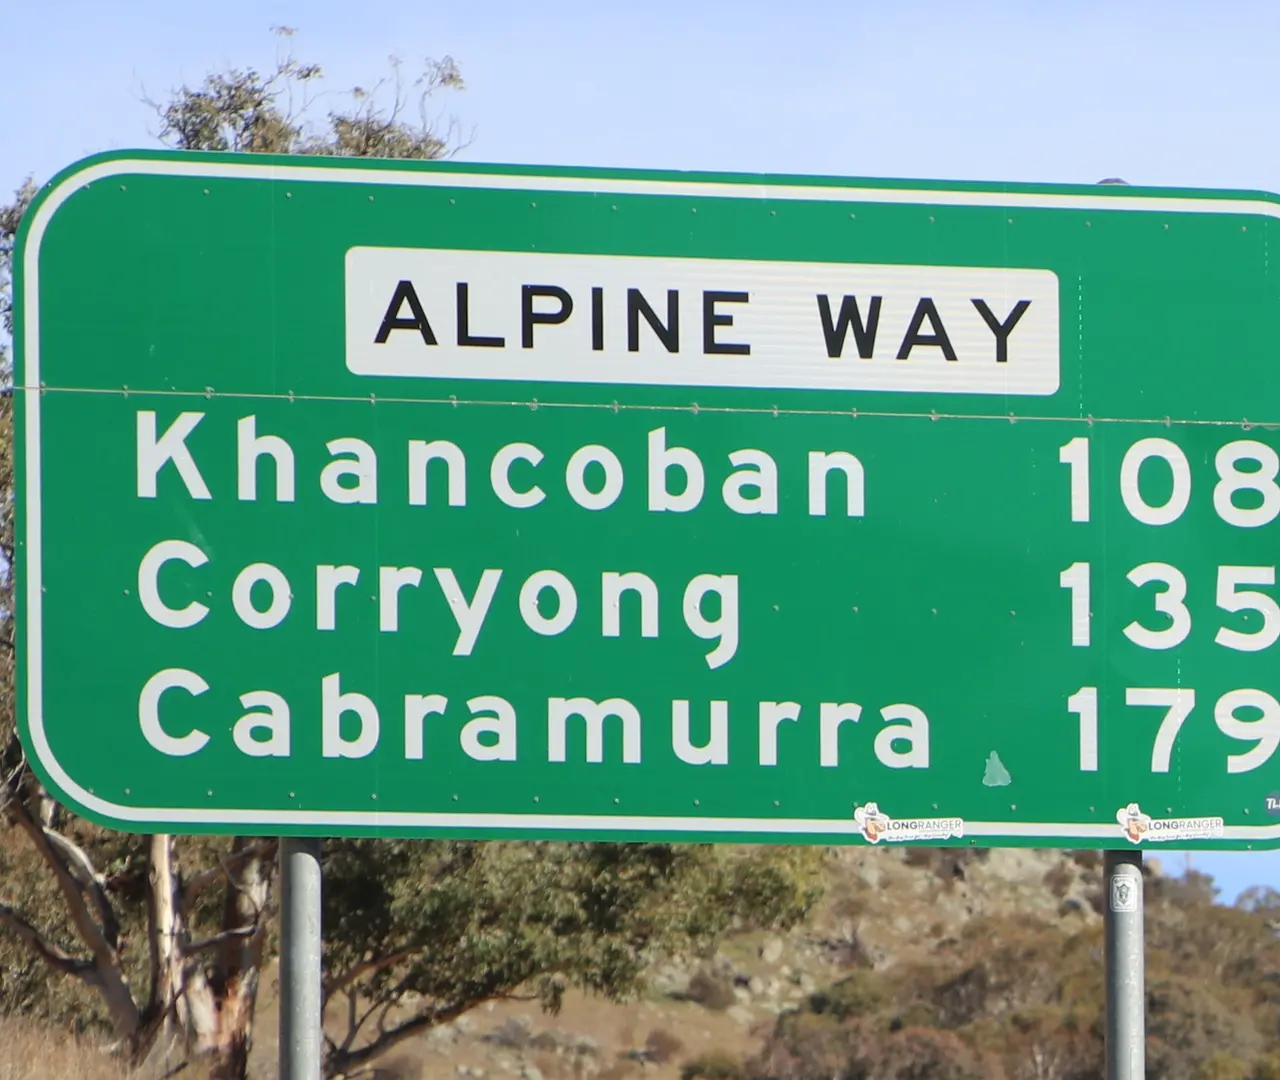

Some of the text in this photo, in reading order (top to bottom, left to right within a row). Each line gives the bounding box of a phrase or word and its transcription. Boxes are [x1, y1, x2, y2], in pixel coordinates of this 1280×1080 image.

[374, 280, 1031, 363] ALPINE WAY
[136, 410, 865, 517] Khancoban
[138, 539, 739, 670] Corryong
[138, 667, 930, 769] Cabramurra
